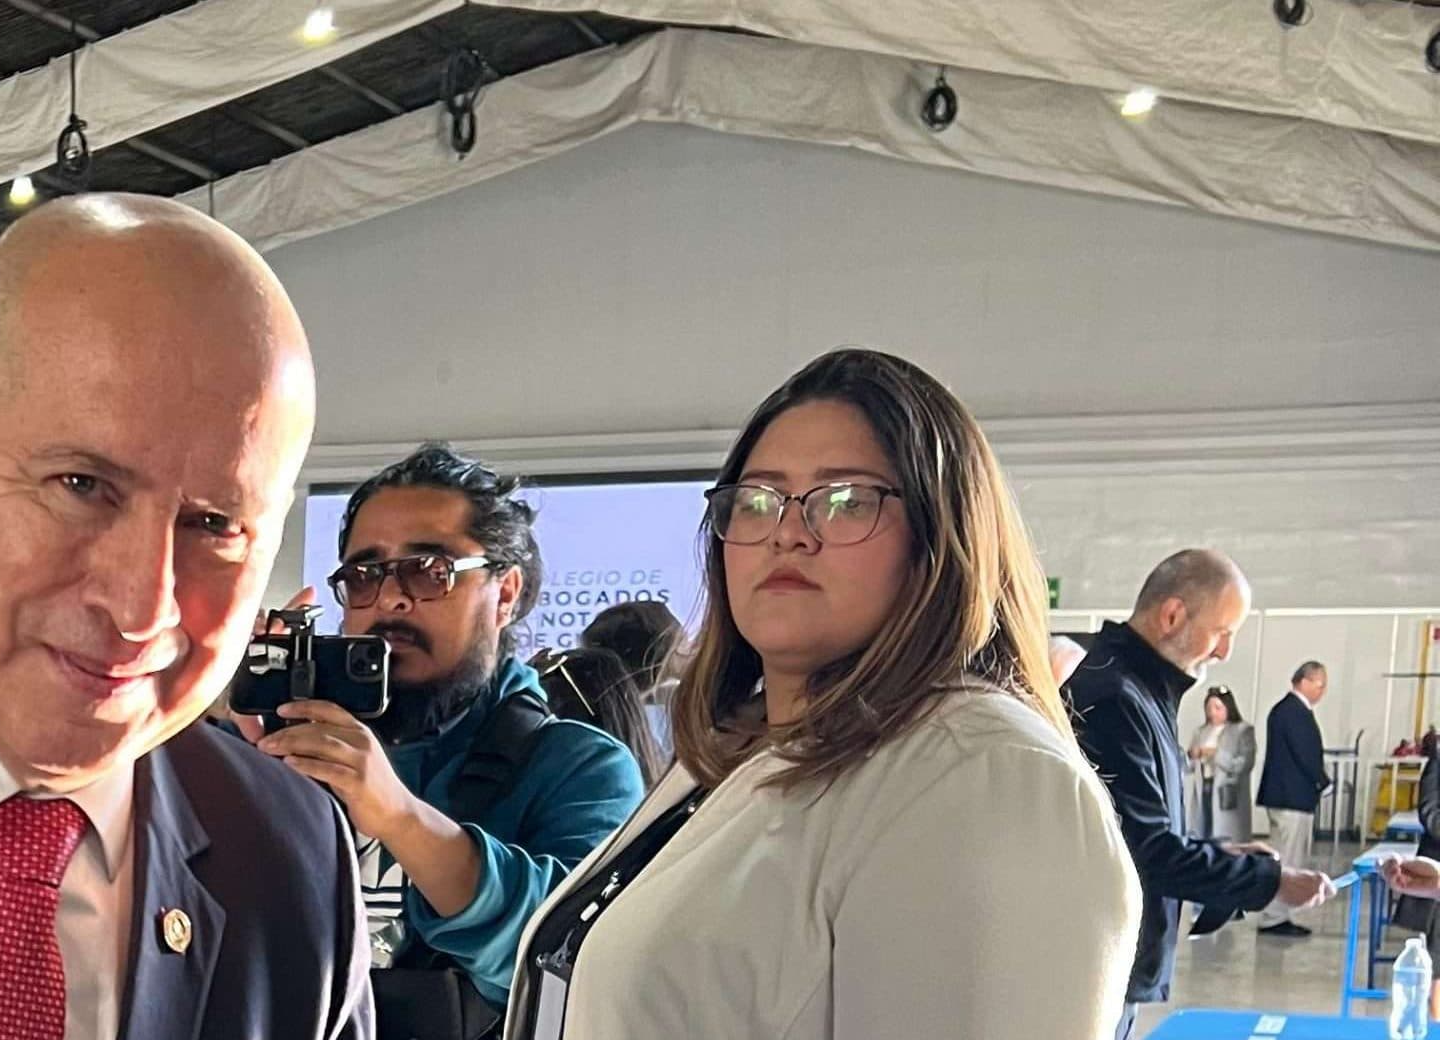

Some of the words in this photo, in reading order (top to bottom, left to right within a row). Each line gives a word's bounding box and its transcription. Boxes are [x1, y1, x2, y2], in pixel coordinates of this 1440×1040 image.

[549, 570, 622, 587] LEGIO
[629, 569, 664, 586] DE
[537, 588, 671, 607] BOGADOS
